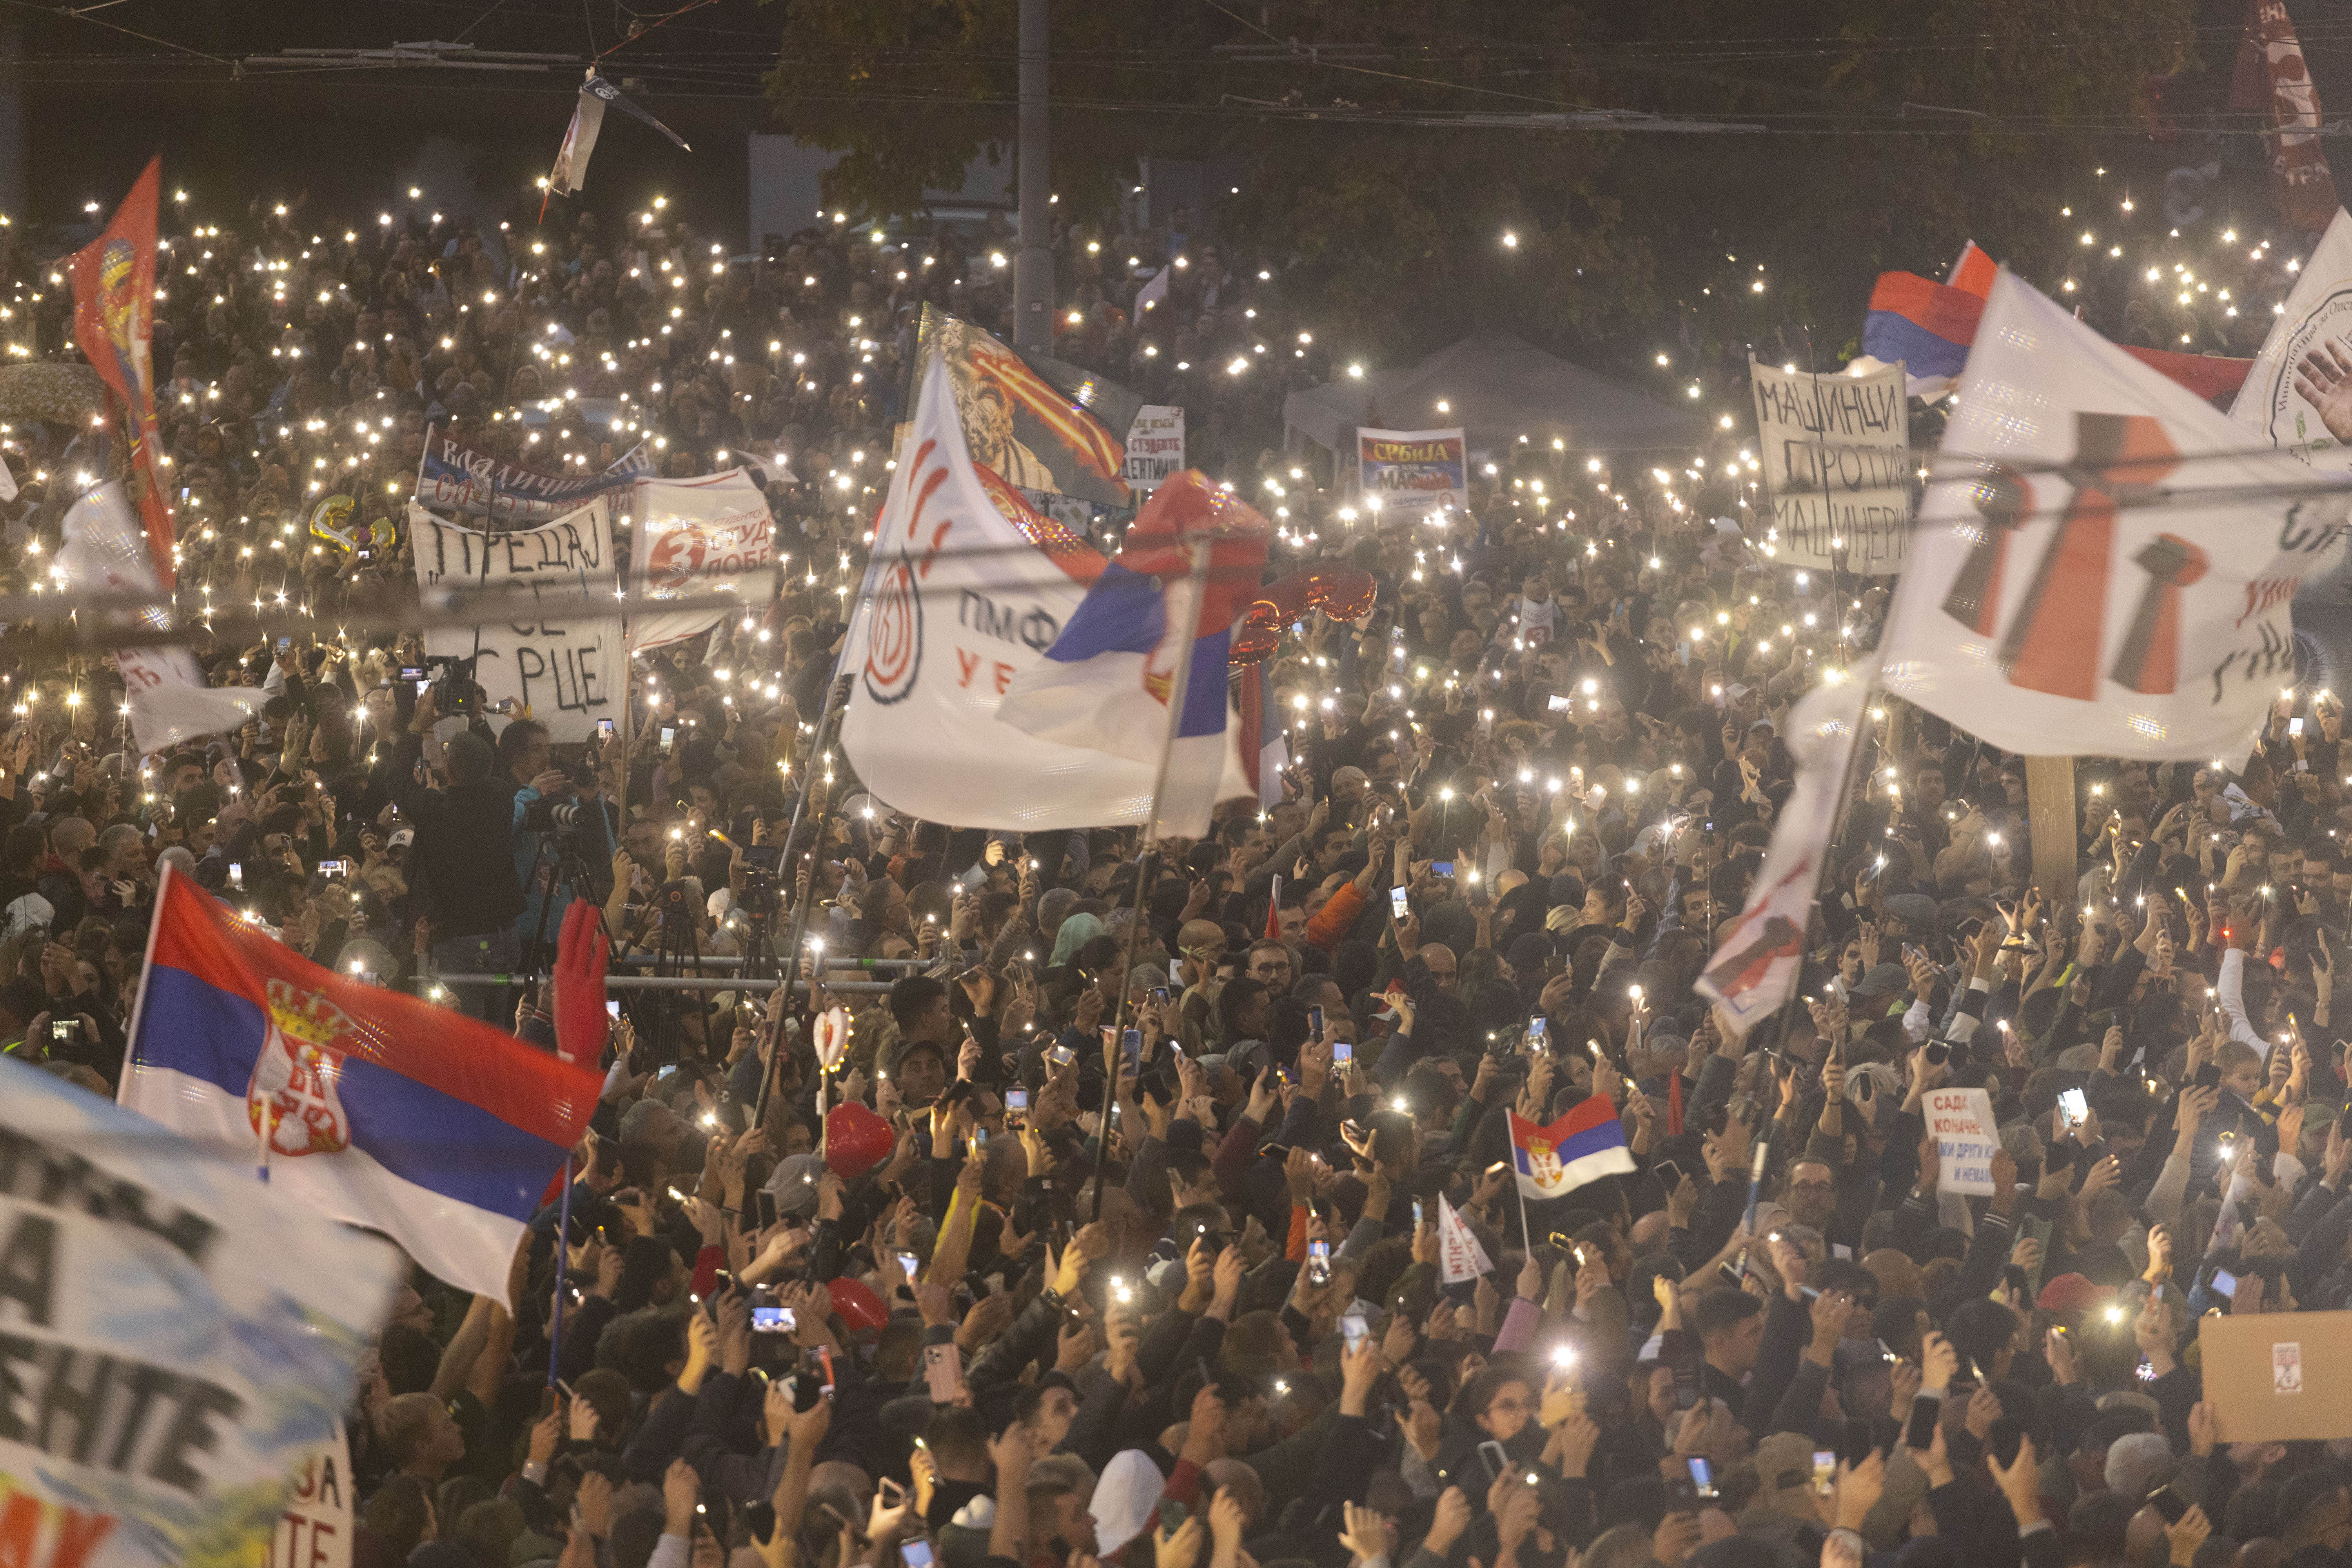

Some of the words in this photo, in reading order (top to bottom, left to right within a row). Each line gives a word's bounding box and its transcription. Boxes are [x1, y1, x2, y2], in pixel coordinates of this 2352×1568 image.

[2319, 312, 2328, 326] за
[1758, 379, 1900, 436] МАШИНЦИ
[396, 833, 406, 842] NY
